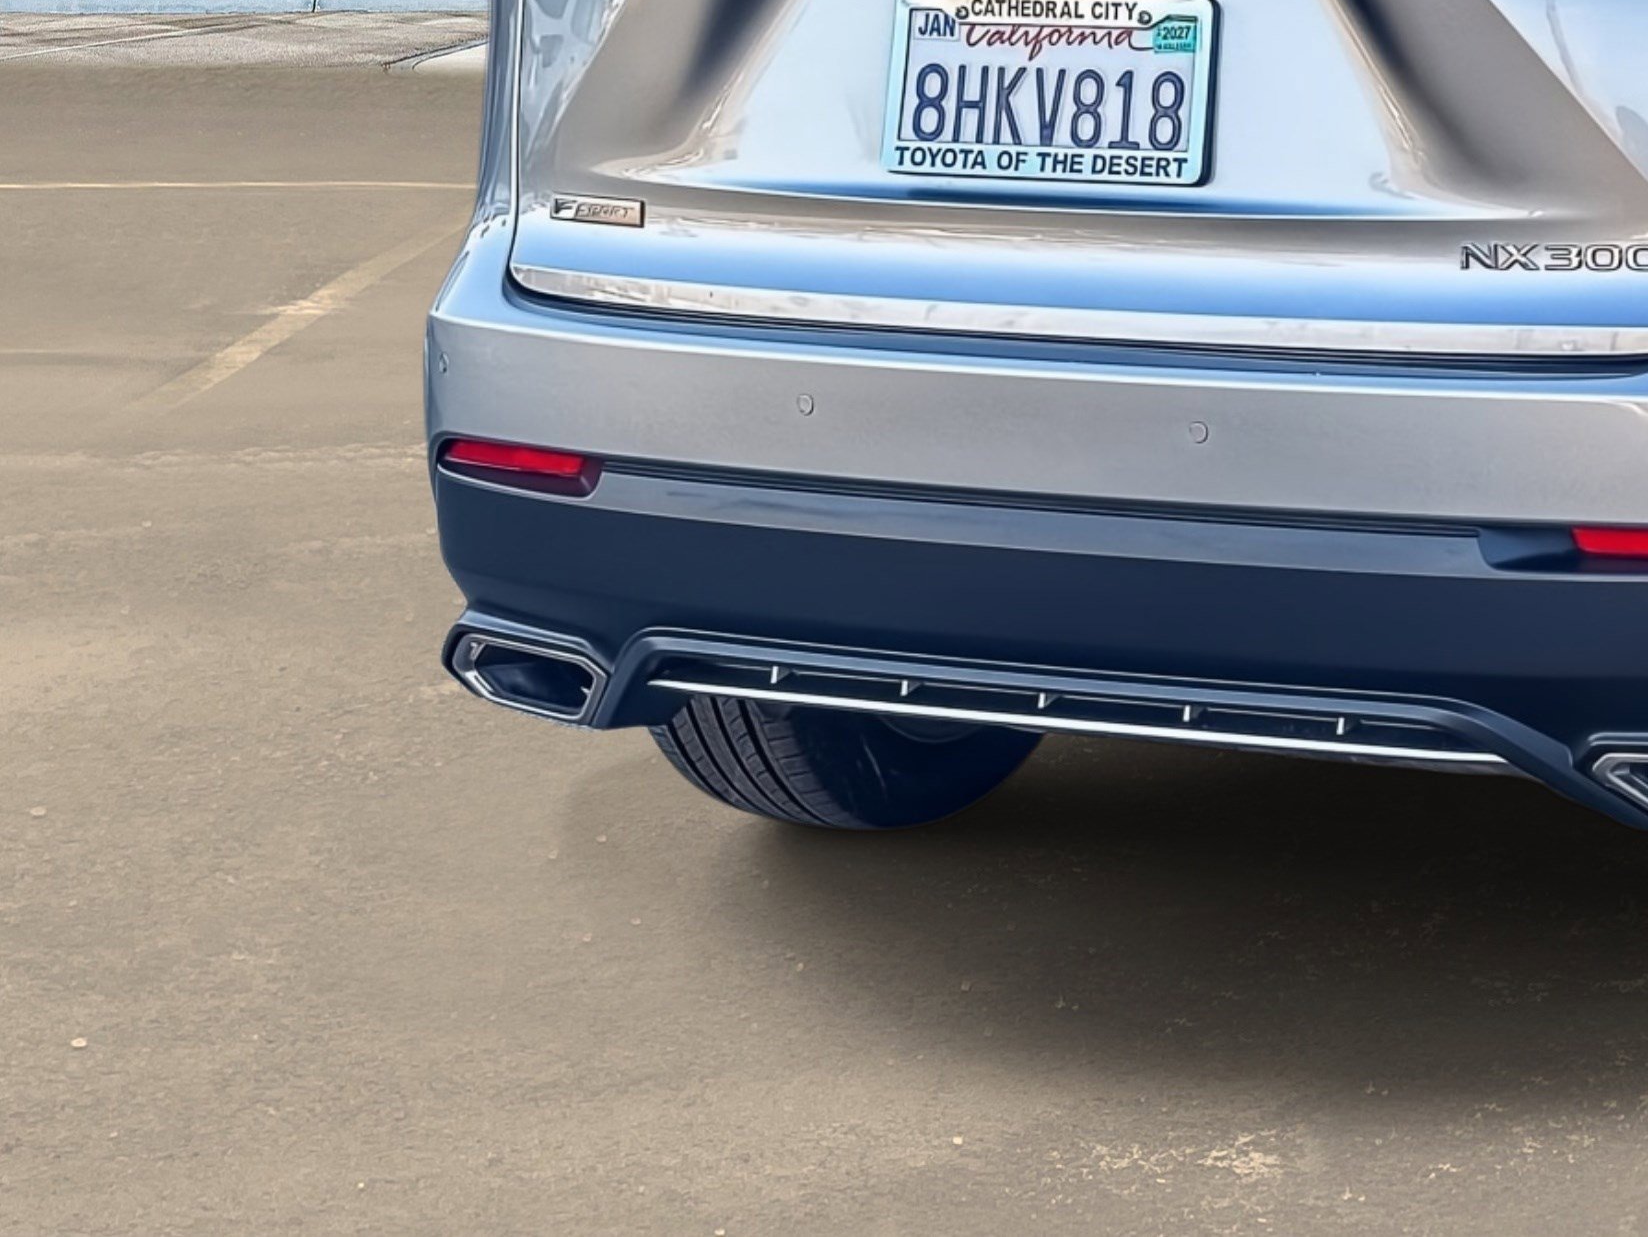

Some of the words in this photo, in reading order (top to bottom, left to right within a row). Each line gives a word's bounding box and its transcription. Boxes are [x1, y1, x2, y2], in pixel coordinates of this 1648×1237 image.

[918, 12, 956, 37] JAN
[1091, 0, 1138, 21] CITY
[965, 23, 1154, 61] California
[1161, 25, 1191, 40] 2027
[911, 62, 1186, 151] 8HKV818
[895, 146, 987, 170] TOYOTA
[996, 151, 1029, 172] OF
[1036, 152, 1084, 174] THE
[1090, 155, 1189, 178] DESERT
